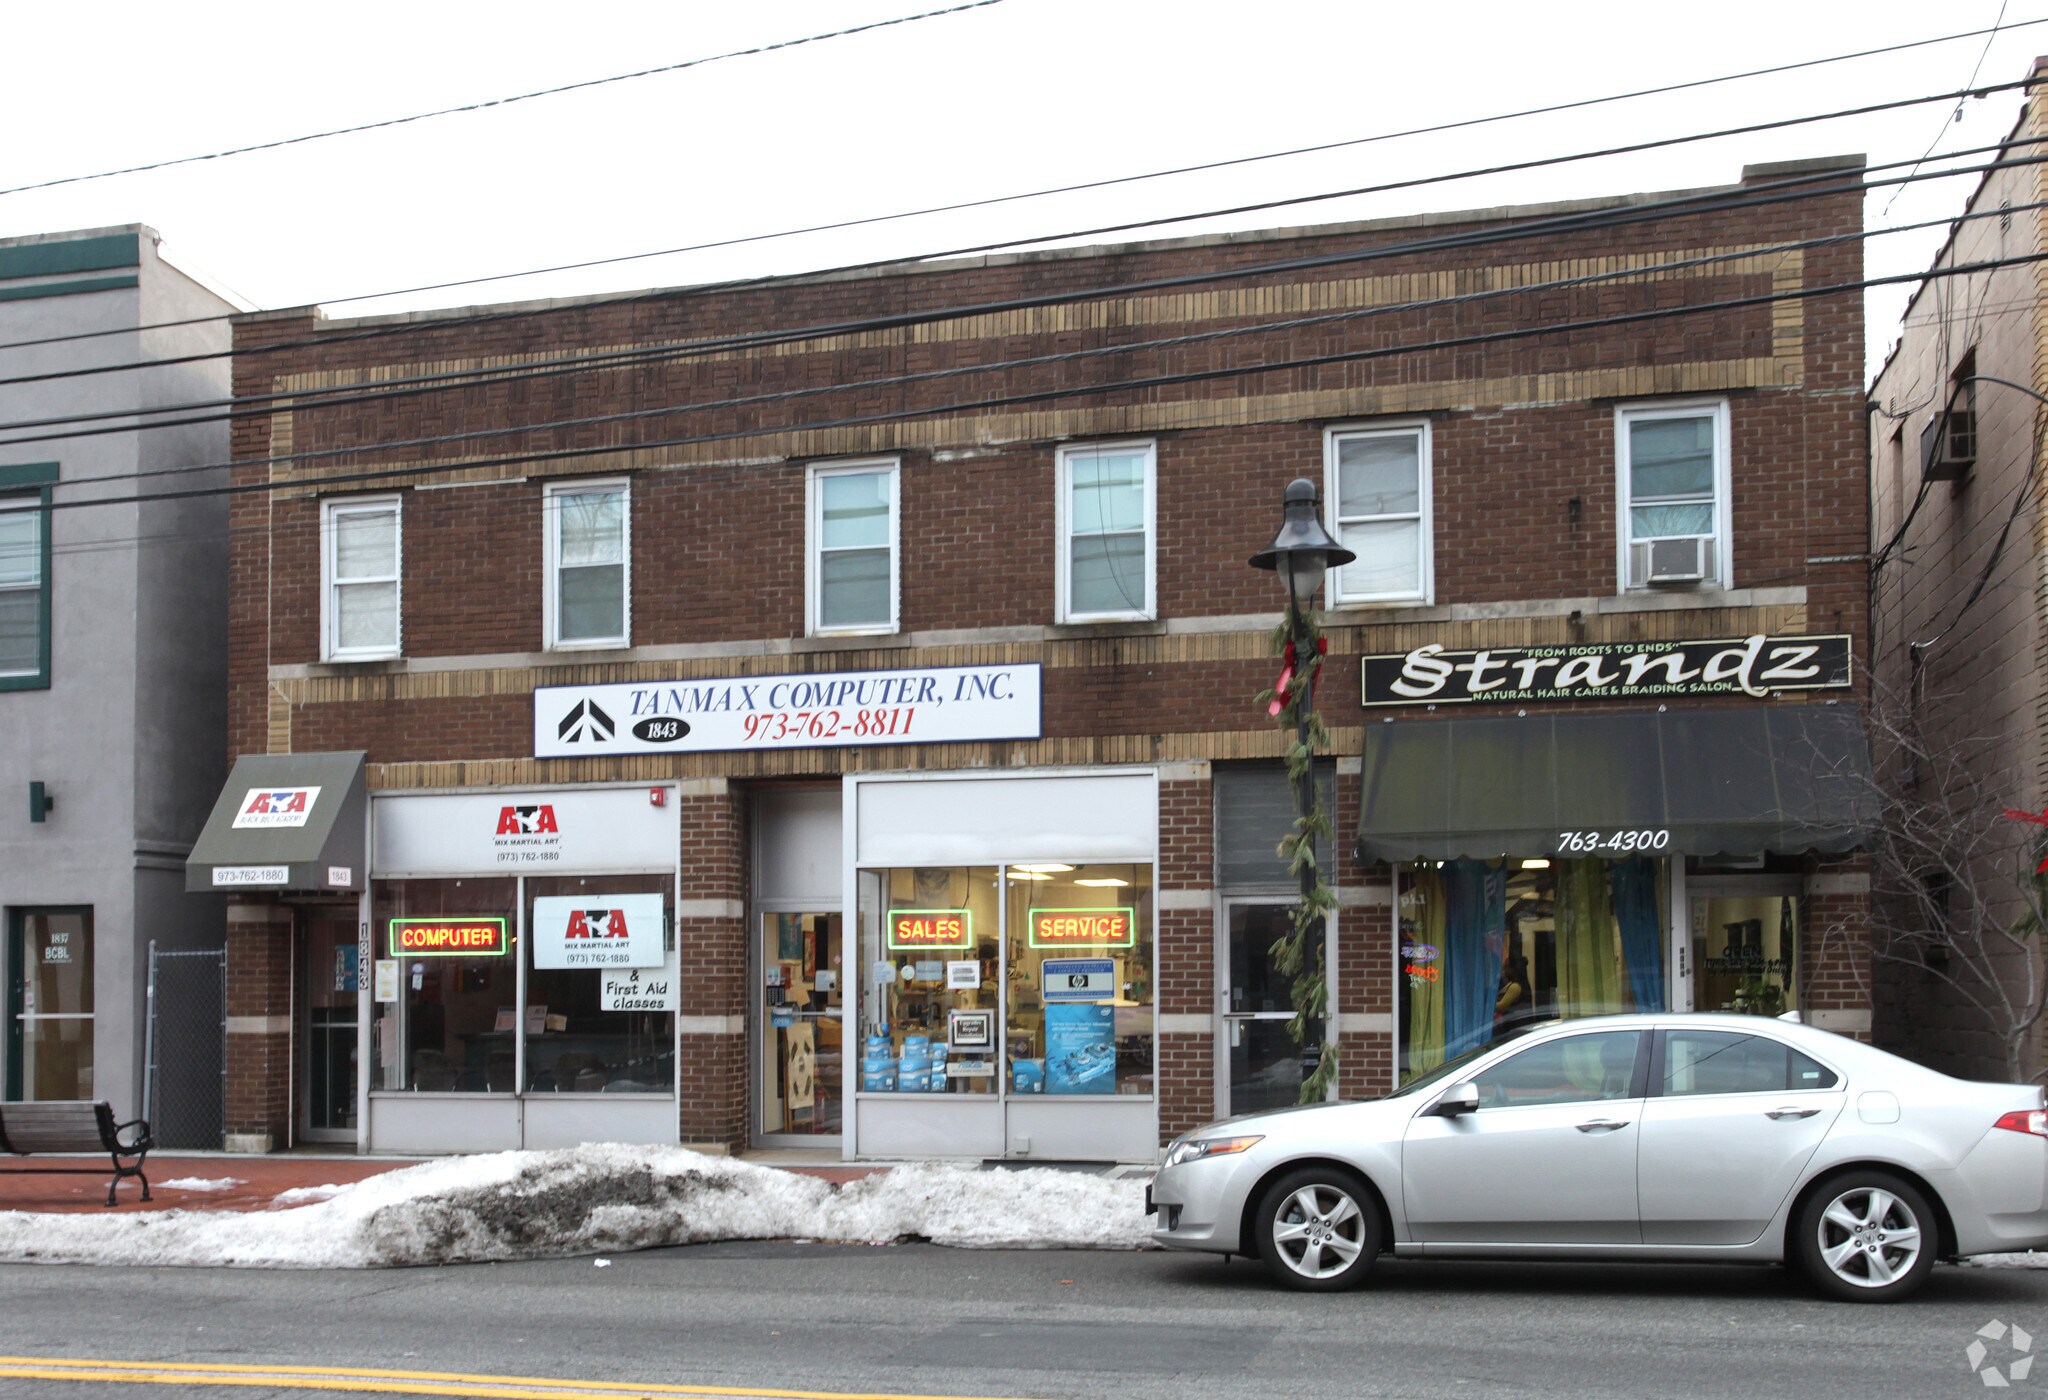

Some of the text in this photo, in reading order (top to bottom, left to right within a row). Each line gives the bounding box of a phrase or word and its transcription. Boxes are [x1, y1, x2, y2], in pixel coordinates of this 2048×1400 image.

[1569, 645, 1612, 656] ROOTS
[1615, 644, 1633, 654] TO
[1390, 634, 1820, 697] Strandz
[629, 672, 1014, 716] TANMAX COMPUTER, INC.
[1472, 689, 1534, 701] NATURAL
[1537, 687, 1571, 698] HAIR
[1574, 686, 1609, 697] CARE
[1621, 684, 1687, 695] BRAIDING
[1689, 682, 1733, 693] SALON
[646, 721, 678, 739] 1843
[742, 706, 915, 742] 973-762-8811
[245, 791, 307, 814] ATA
[496, 804, 559, 835] ATA
[1557, 829, 1670, 852] 763-4300
[497, 852, 560, 863] (973) 762-1880
[217, 870, 284, 881] 973-762-1880
[565, 909, 629, 939] ATA
[898, 919, 960, 939] SALES
[1040, 917, 1123, 938] SERVICE
[402, 928, 493, 946] COMPUTER
[566, 954, 630, 965] (973) 762-1880
[629, 970, 639, 982] &
[606, 982, 668, 995] First Aid
[613, 997, 665, 1009] classes
